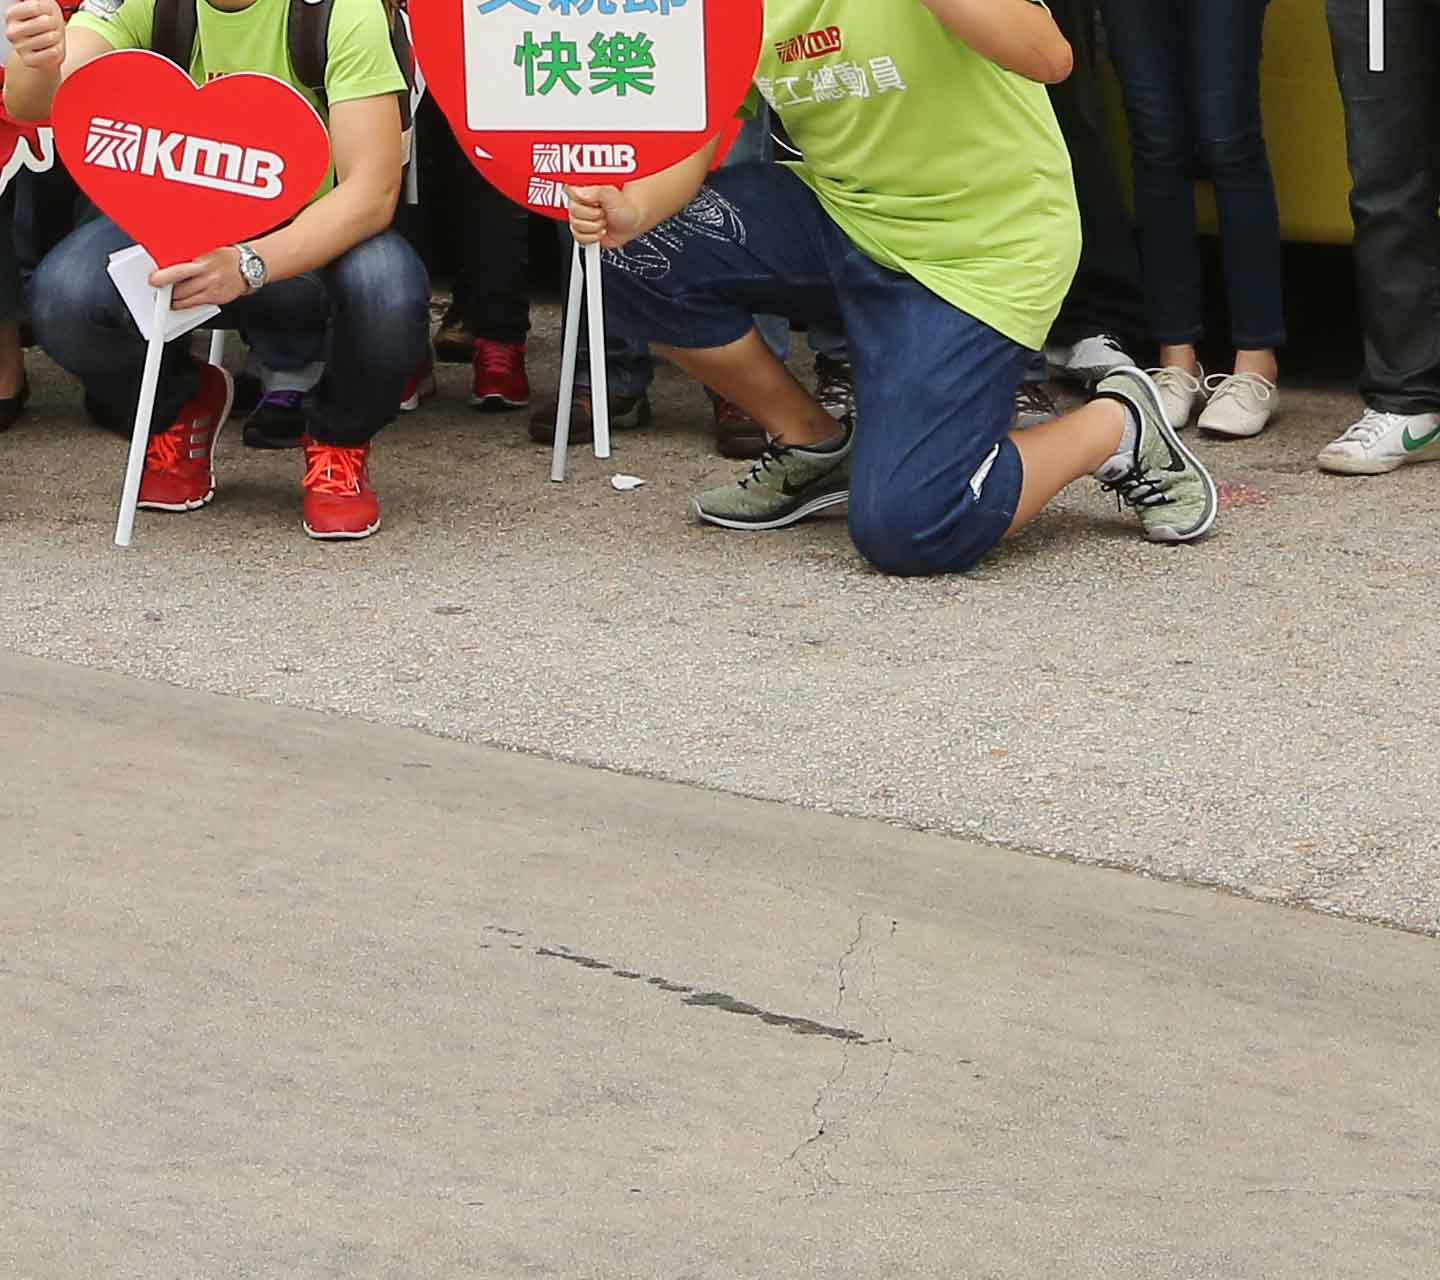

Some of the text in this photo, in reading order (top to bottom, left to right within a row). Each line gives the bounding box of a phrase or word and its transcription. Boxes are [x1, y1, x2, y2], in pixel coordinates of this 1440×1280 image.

[513, 31, 657, 98] 快樂
[140, 127, 285, 199] KMB
[561, 144, 638, 174] KMB
